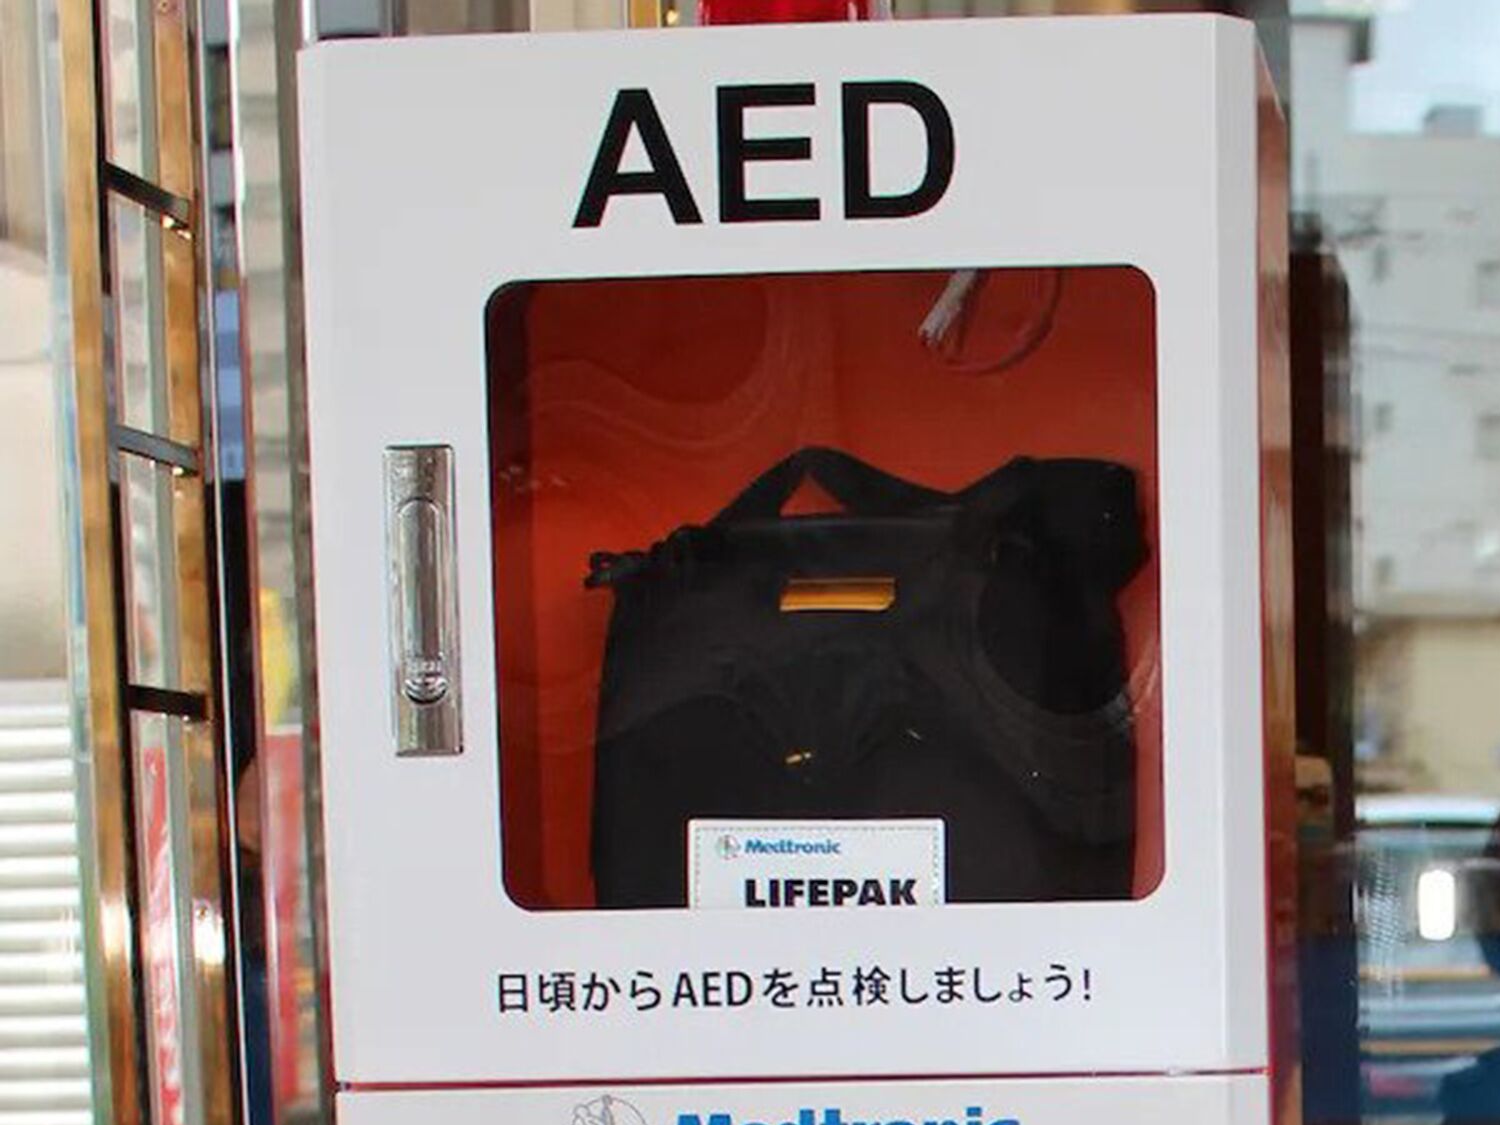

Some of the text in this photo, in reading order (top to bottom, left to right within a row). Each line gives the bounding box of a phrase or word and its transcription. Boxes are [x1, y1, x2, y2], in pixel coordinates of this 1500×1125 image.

[572, 81, 955, 229] AED
[743, 836, 840, 855] Medtronic
[745, 879, 918, 907] LIFEPAK
